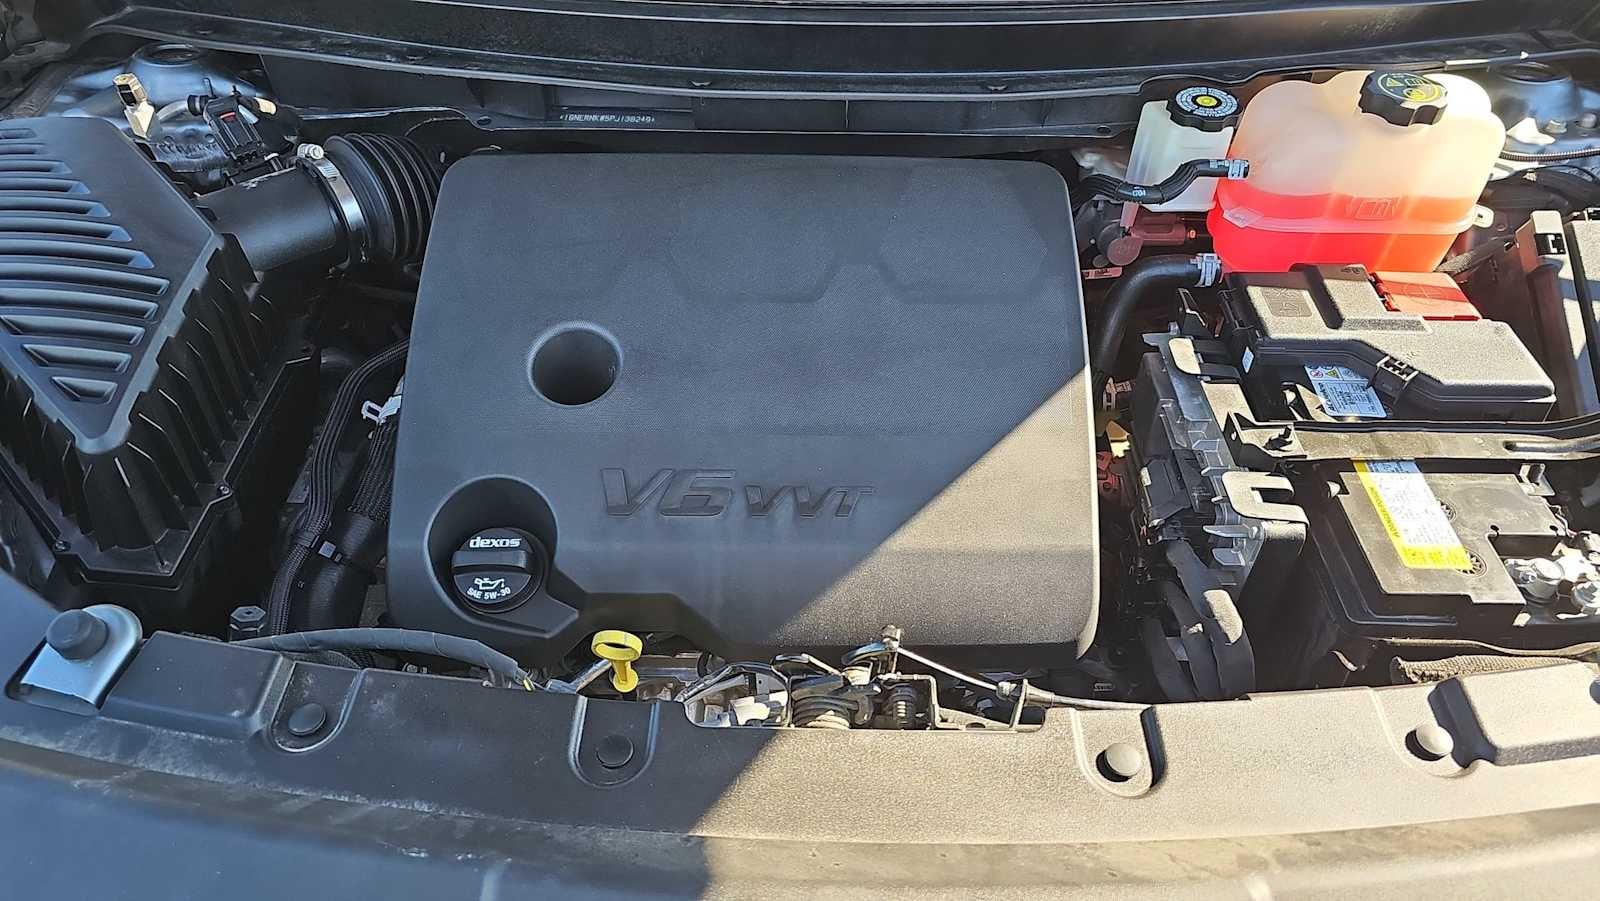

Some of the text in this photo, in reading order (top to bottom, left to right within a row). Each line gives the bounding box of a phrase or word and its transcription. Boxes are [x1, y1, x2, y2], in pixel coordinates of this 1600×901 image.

[600, 468, 876, 518] V6 VVT
[469, 537, 522, 548] dexos
[467, 587, 511, 599] SAE 5W-30
